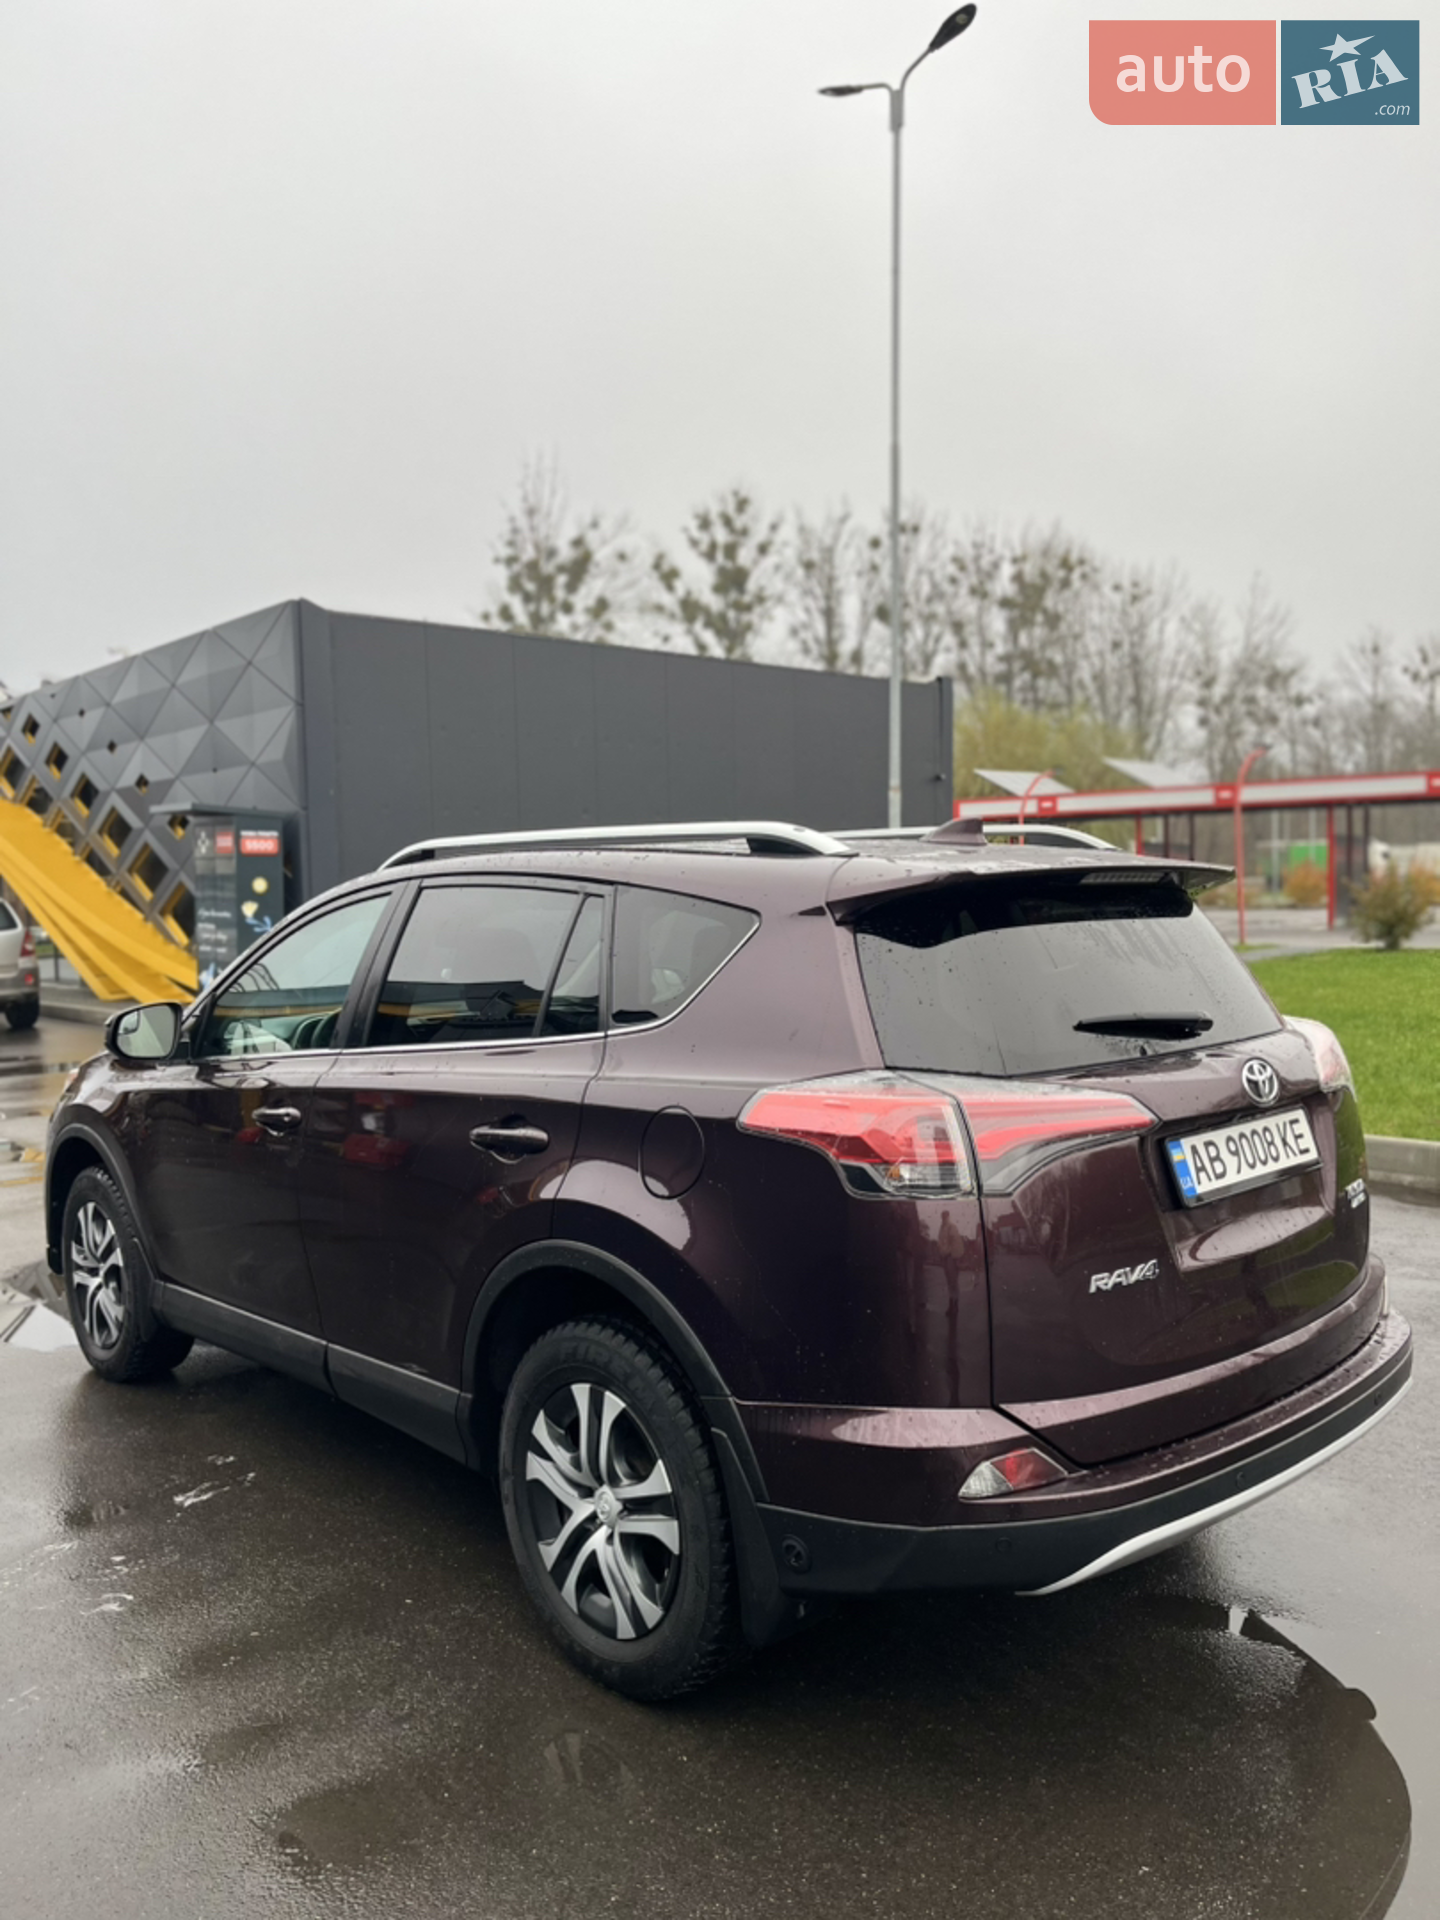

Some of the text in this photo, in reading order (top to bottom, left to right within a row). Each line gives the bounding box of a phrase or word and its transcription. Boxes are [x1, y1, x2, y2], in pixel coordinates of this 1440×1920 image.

[1190, 1118, 1311, 1186] AB 9008 KE
[1089, 1258, 1160, 1294] RAV4
